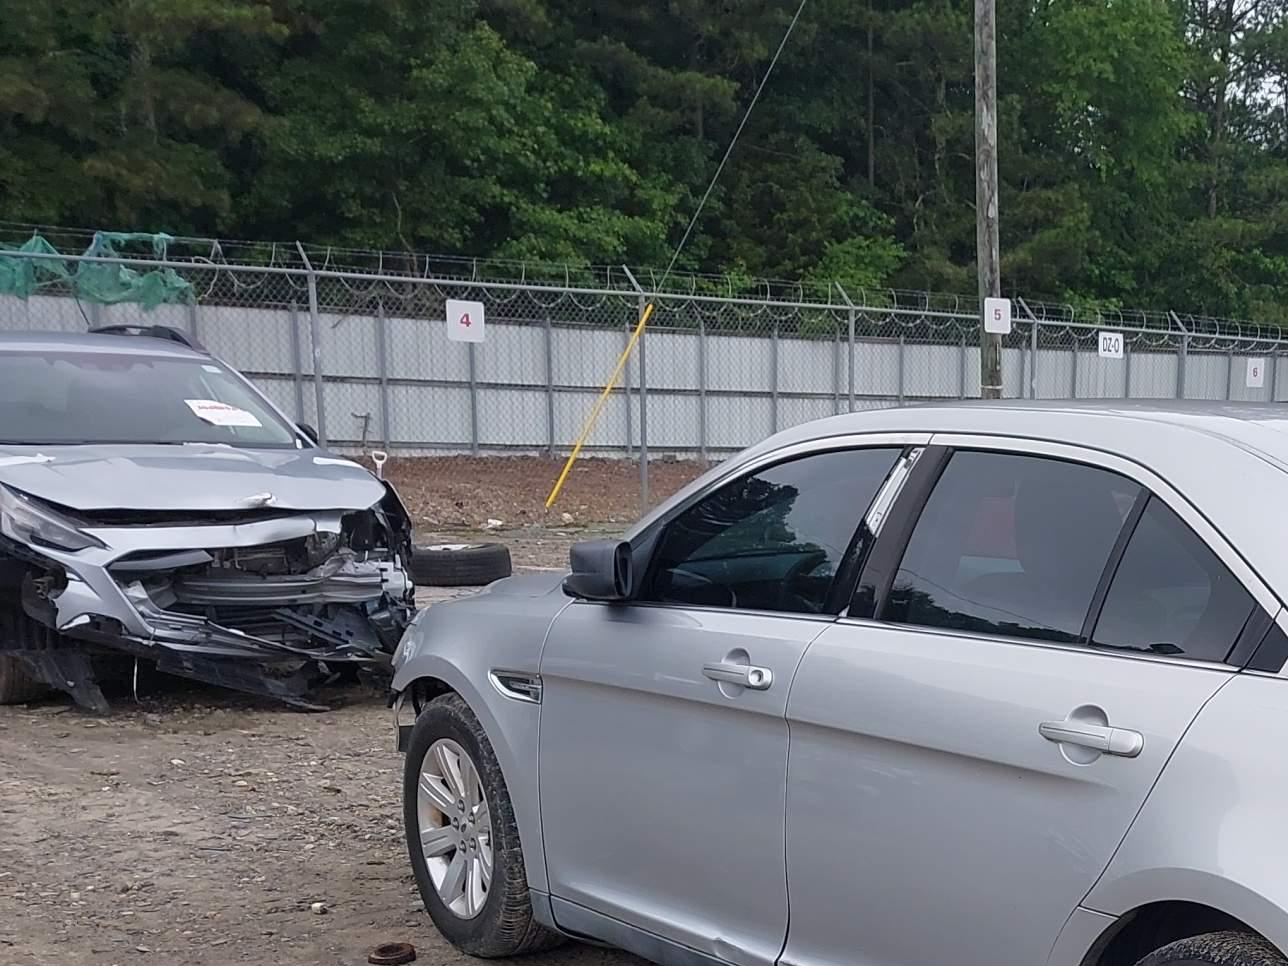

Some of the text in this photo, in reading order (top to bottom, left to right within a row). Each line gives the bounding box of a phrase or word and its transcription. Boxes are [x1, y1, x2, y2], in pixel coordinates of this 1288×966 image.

[460, 313, 471, 327] 4
[994, 309, 1001, 320] 5
[1252, 367, 1258, 377] 6
